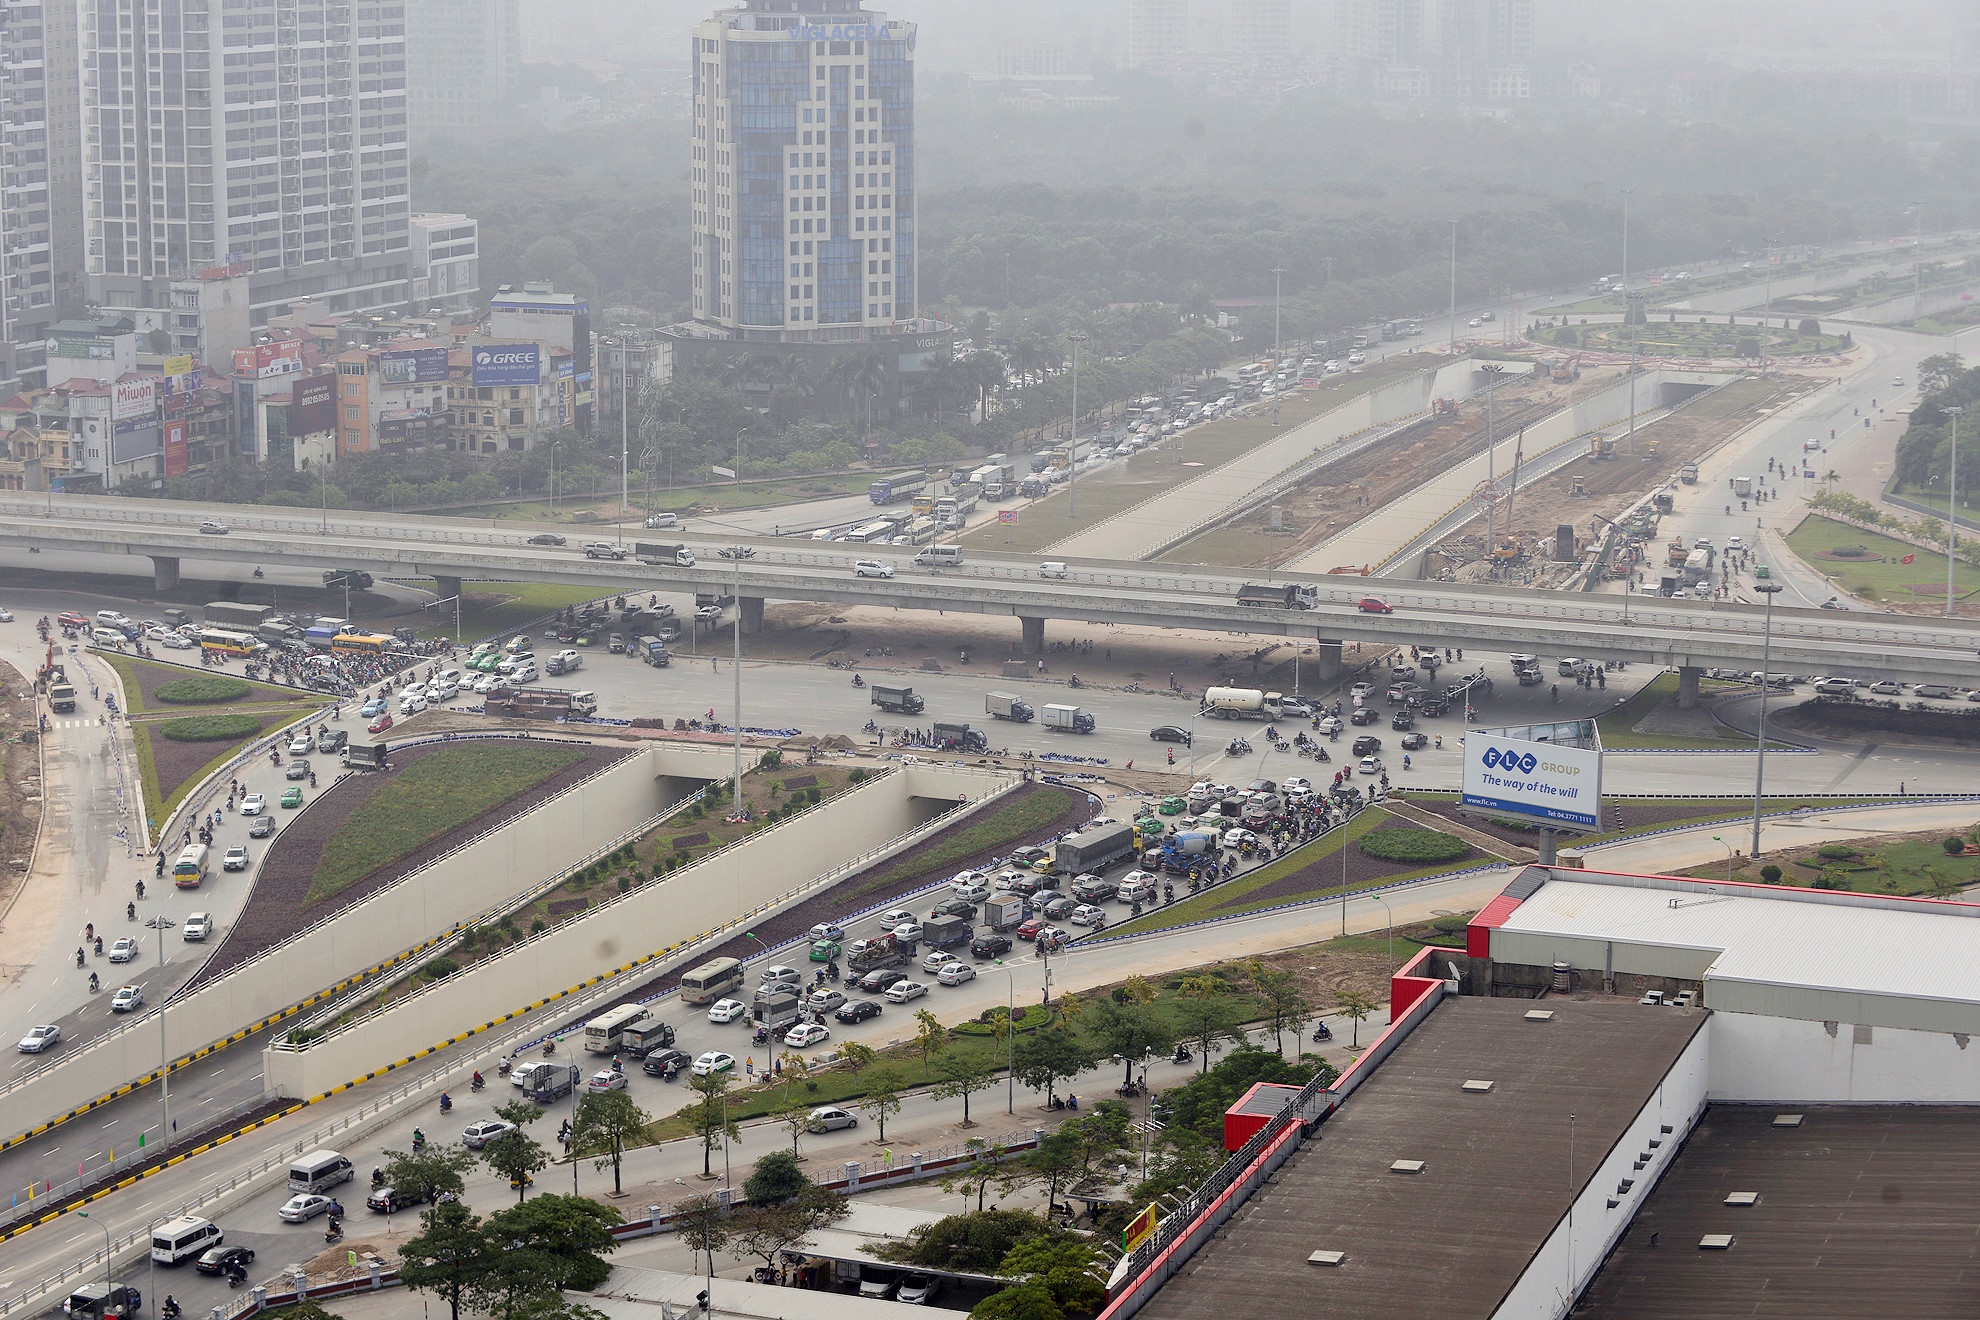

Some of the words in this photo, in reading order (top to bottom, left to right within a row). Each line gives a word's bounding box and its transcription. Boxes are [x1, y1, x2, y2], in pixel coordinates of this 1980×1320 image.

[788, 24, 891, 40] VIGLACERA
[916, 335, 949, 348] VIGLACE
[492, 352, 535, 364] GREE
[117, 386, 151, 402] Miwon
[1485, 750, 1534, 772] FLC
[1541, 762, 1580, 776] GROUP
[1482, 773, 1501, 786] The
[1503, 779, 1524, 792] way
[1526, 780, 1538, 792] of
[1540, 783, 1556, 795] the
[1558, 788, 1578, 799] will
[1466, 797, 1497, 807] www.flc.vn
[1557, 811, 1578, 821] 04.3771
[1579, 814, 1592, 823] 1111
